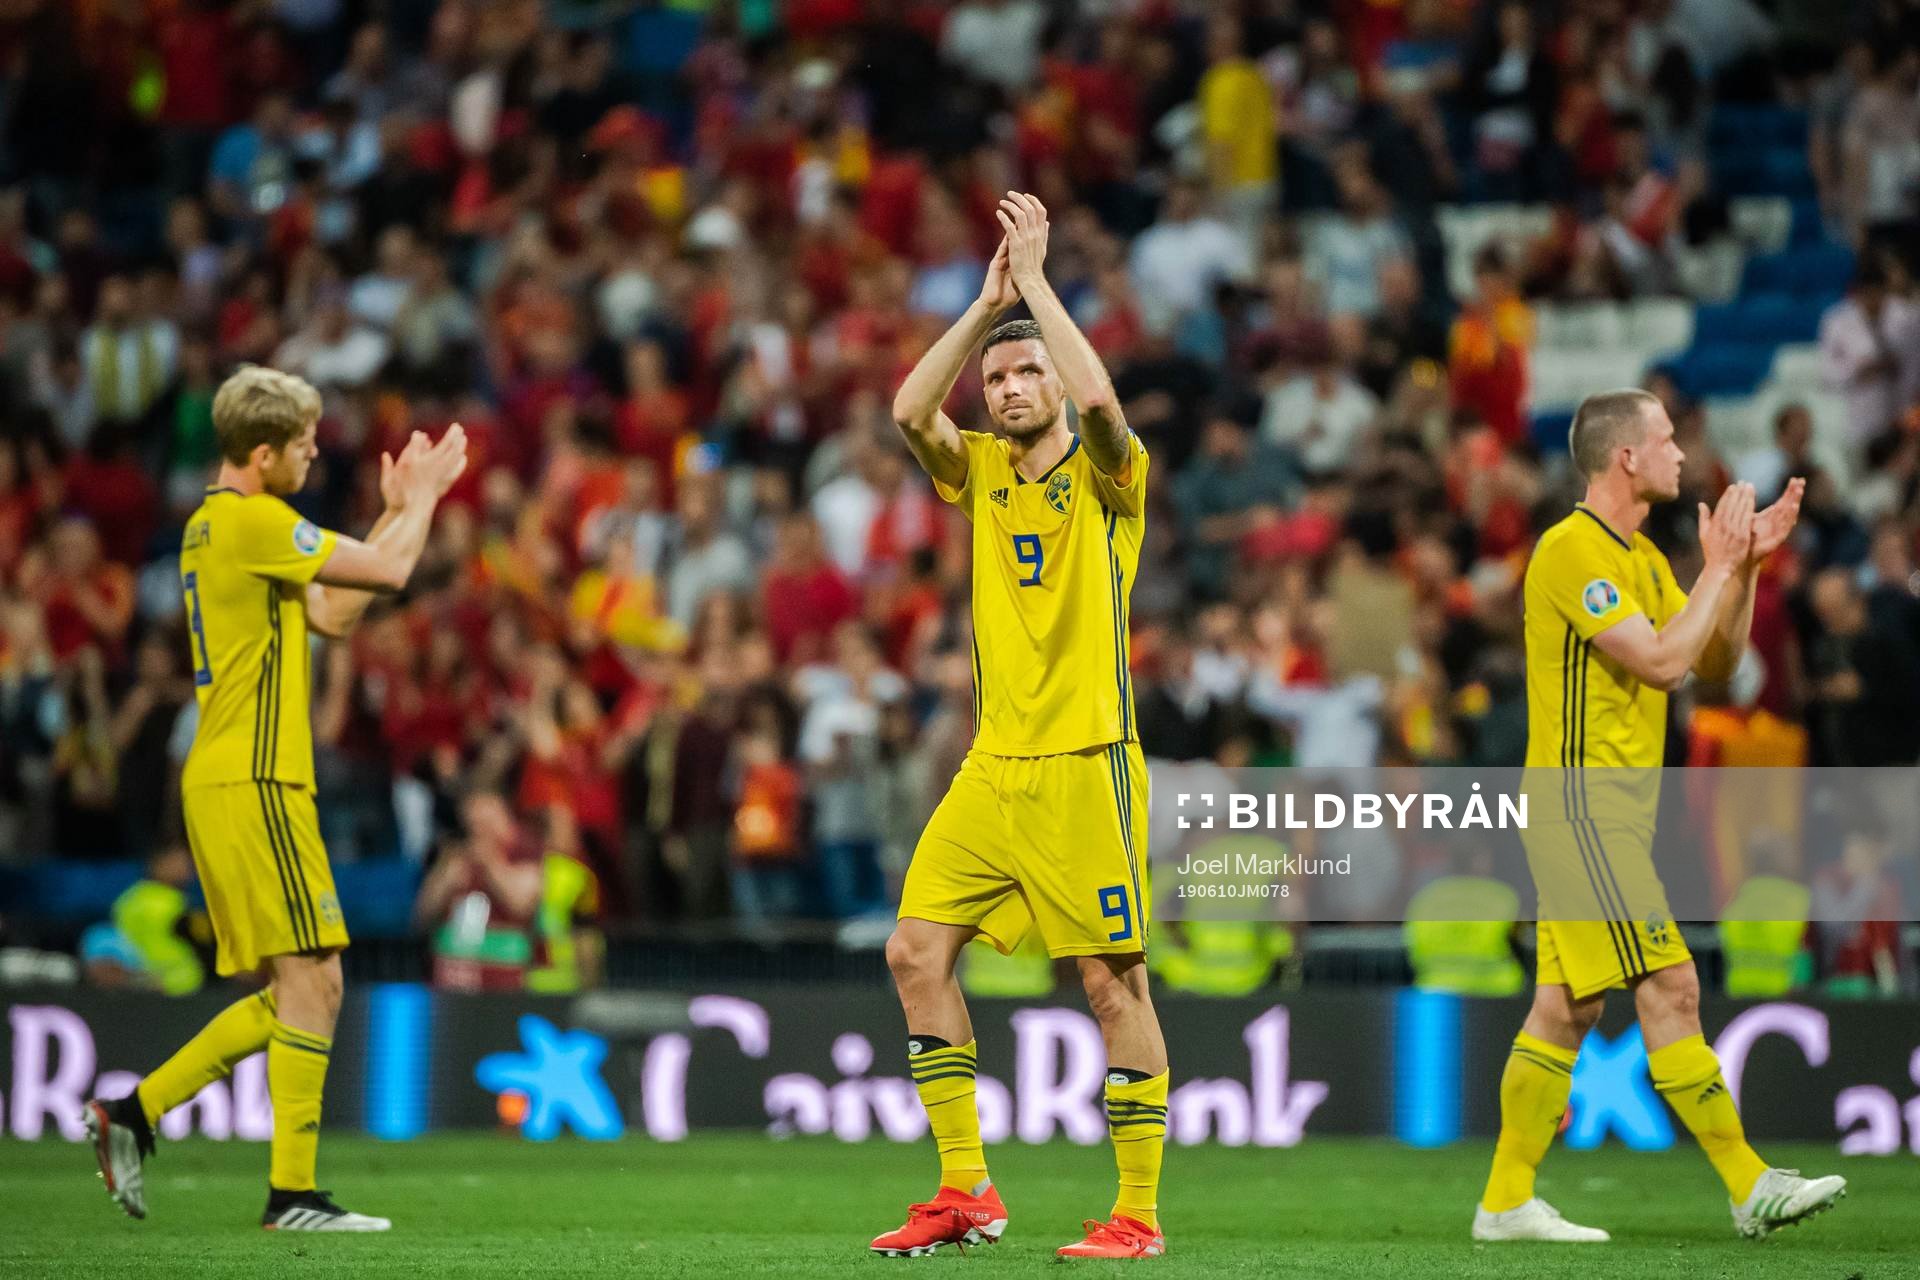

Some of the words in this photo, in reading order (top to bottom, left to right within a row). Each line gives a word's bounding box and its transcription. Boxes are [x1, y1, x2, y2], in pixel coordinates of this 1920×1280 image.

[1012, 534, 1043, 587] 9
[1097, 885, 1133, 942] 9
[641, 994, 1329, 1147] CaixBnk
[951, 1209, 990, 1220] NEESIS
